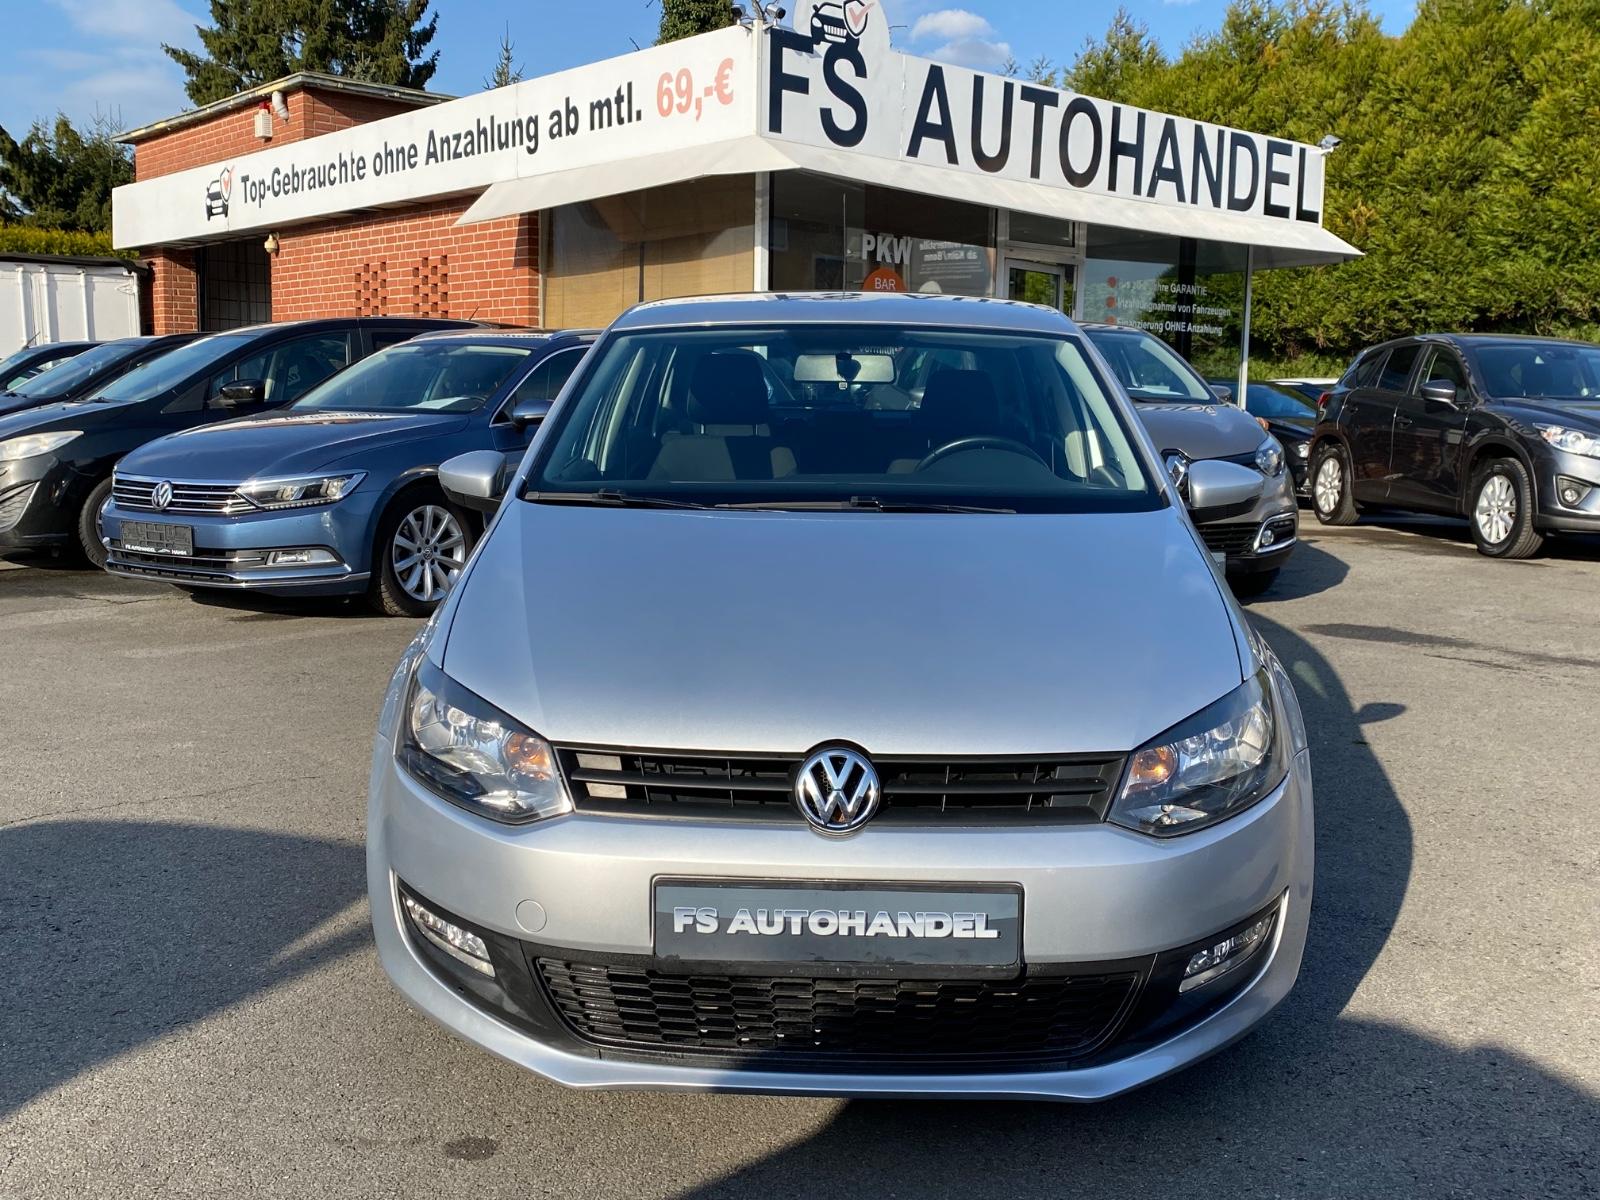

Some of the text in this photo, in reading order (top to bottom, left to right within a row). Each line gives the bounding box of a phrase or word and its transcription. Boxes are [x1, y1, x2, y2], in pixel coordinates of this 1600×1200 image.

[768, 28, 1320, 224] FS AUTOHANDEL
[241, 152, 366, 208] Top-Gebrauchte
[372, 141, 418, 177] ohne
[425, 114, 539, 166] Anzahlung
[549, 96, 579, 140] ab
[590, 81, 642, 131] mtl.
[862, 233, 912, 264] PKW
[874, 277, 896, 290] BAR
[1170, 283, 1207, 296] GARANTIE
[1178, 305, 1191, 313] von
[1192, 303, 1231, 316] Fahrzeugen
[1165, 321, 1186, 332] OHNE
[1187, 322, 1223, 336] Anzahlung
[673, 907, 998, 938] FS AUTOHANDEL
